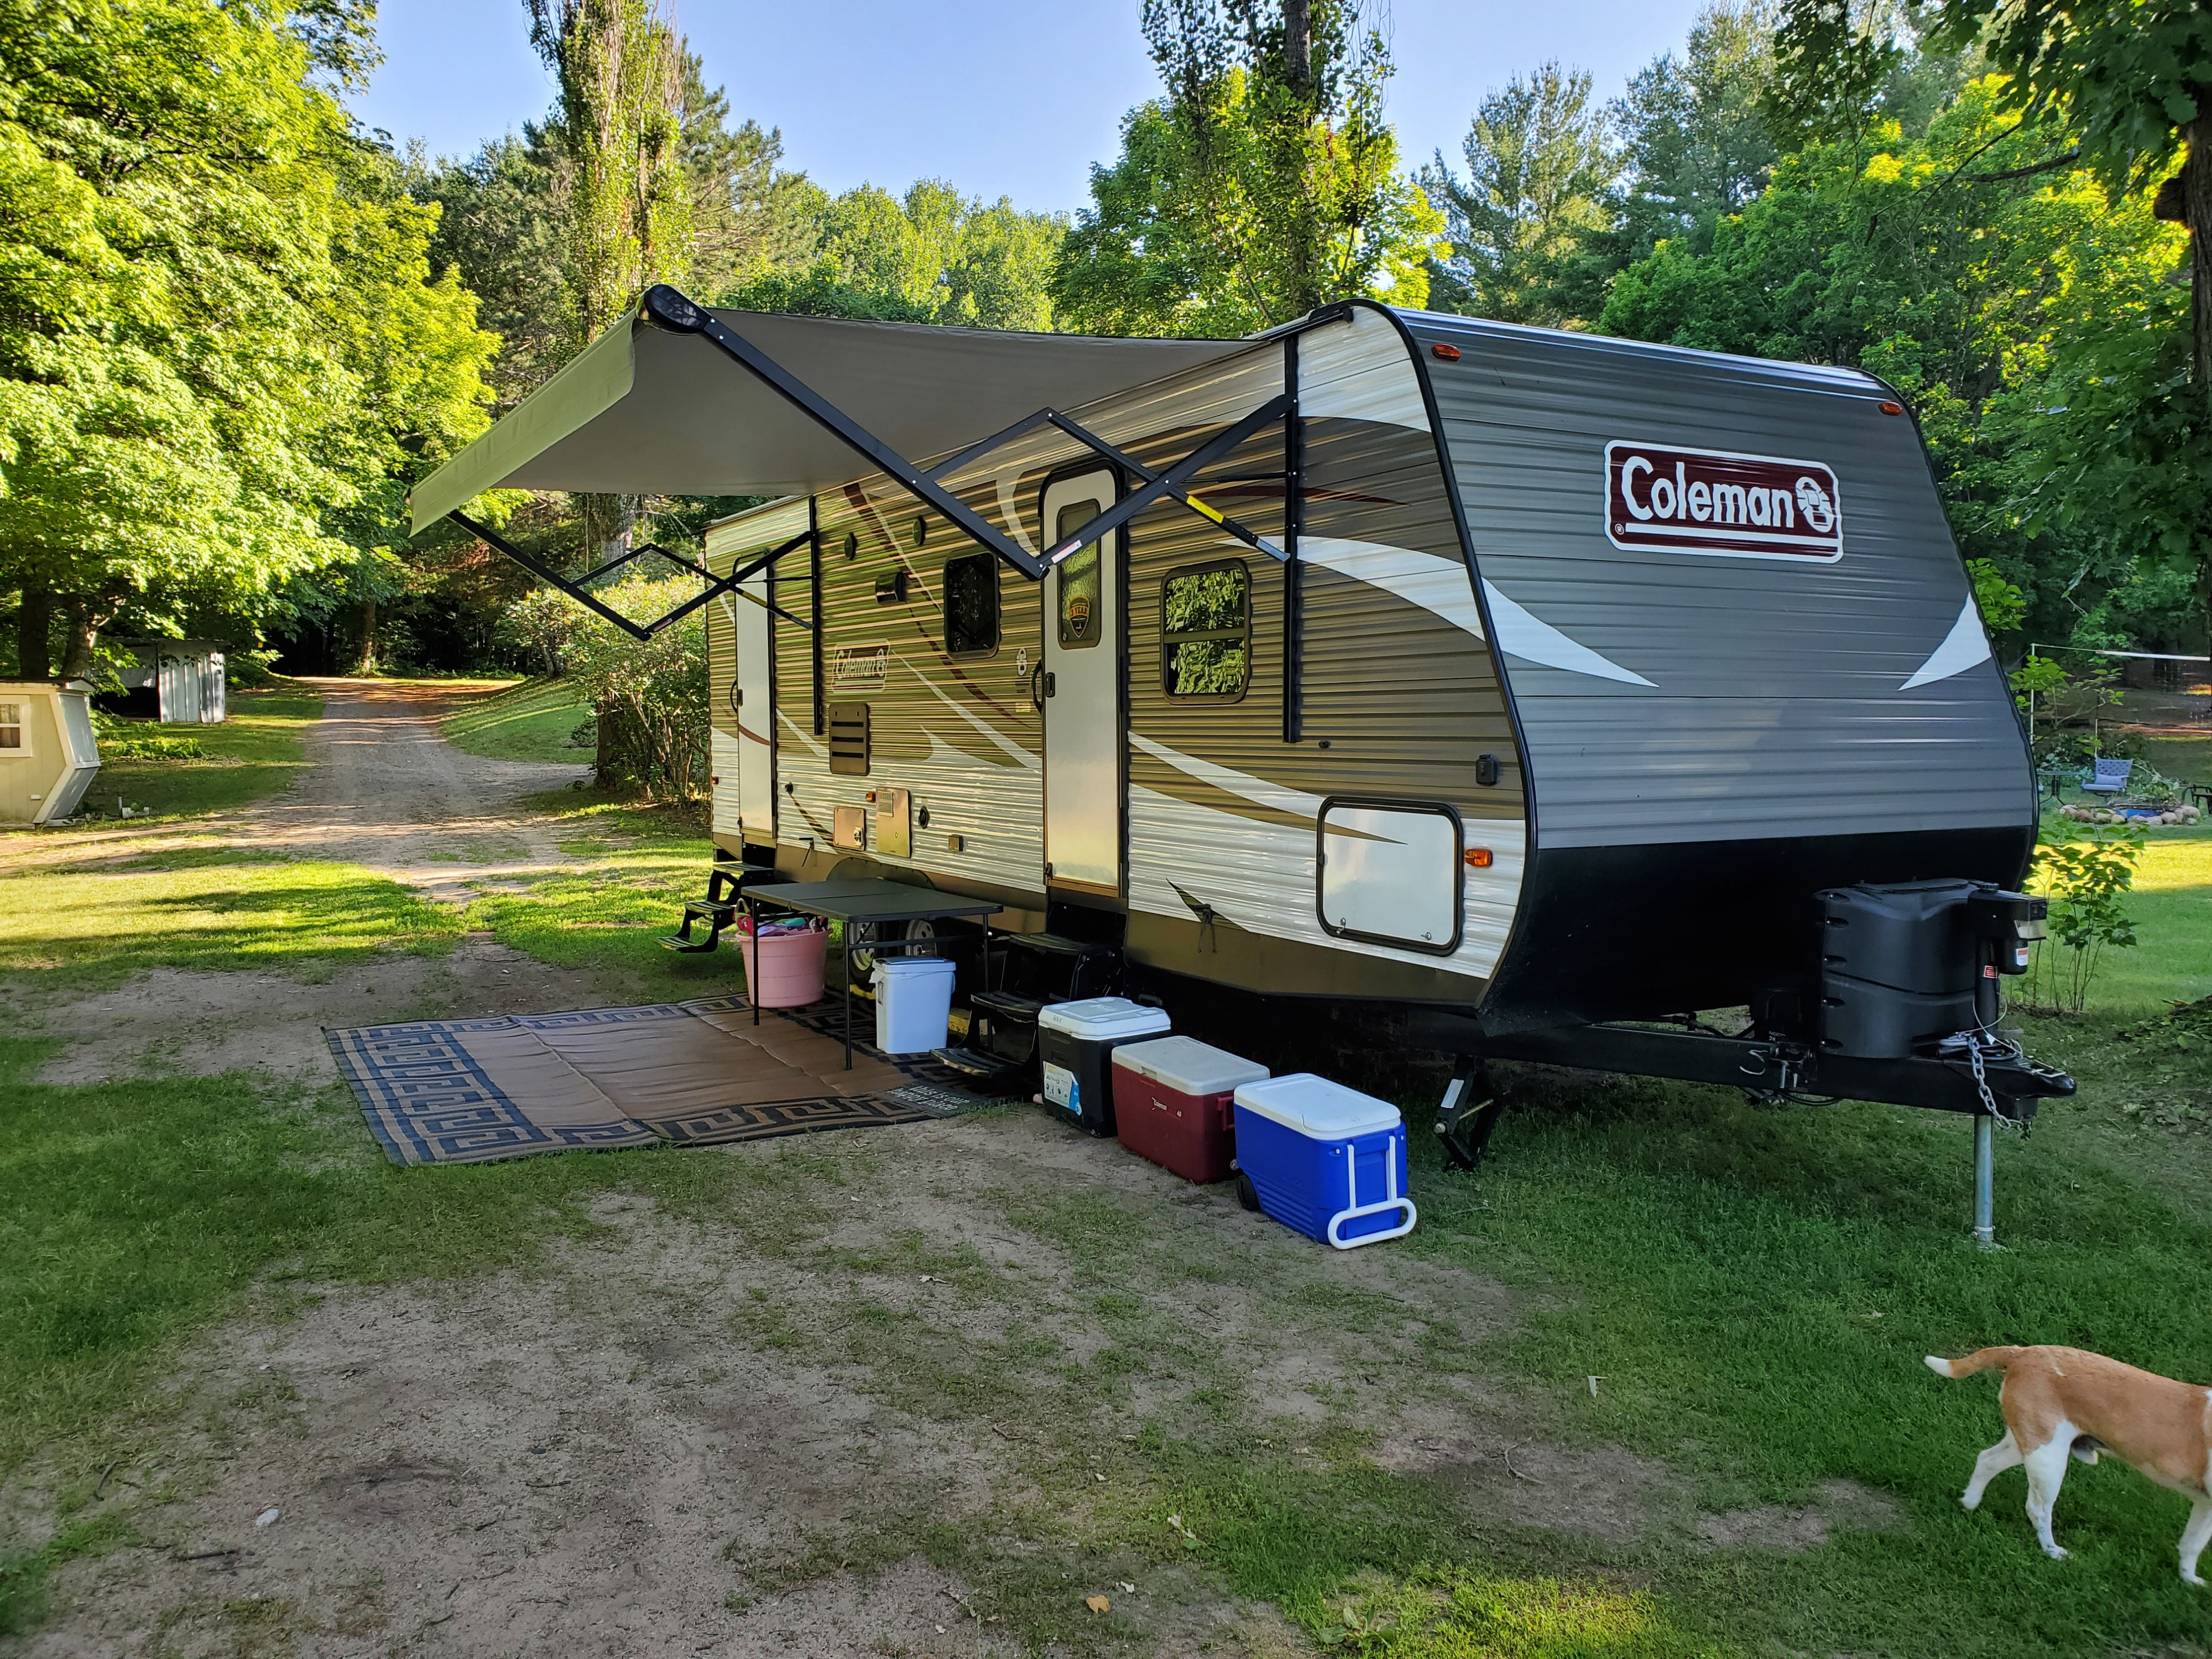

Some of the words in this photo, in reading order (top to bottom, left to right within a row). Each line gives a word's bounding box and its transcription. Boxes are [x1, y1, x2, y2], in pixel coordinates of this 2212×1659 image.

[1621, 456, 1794, 529] Coleman
[1074, 606, 1088, 615] YEAR
[836, 649, 876, 680] Coleman
[887, 1087, 930, 1104] happy
[917, 1099, 959, 1110] place
[909, 1085, 937, 1095] this
